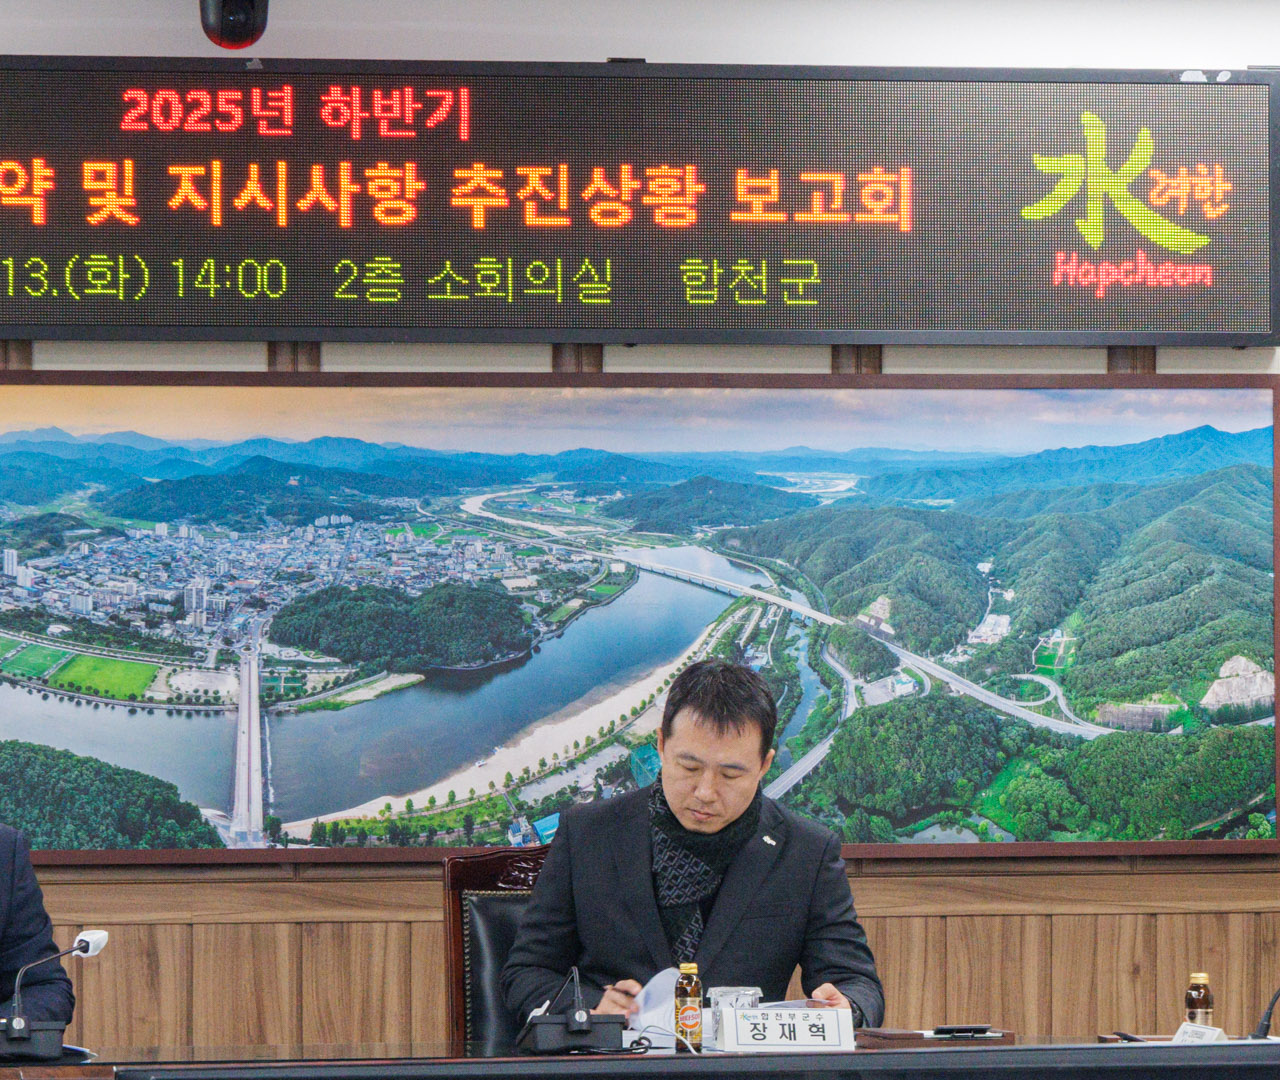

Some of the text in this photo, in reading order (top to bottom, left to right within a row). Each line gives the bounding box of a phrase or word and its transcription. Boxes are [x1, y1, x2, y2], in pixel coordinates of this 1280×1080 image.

[120, 86, 472, 142] 2025년 하반기
[80, 158, 141, 226] 및
[167, 159, 427, 230] 지시사항
[450, 162, 707, 231] 추진상황
[729, 166, 913, 233] 보고회
[170, 258, 286, 298] 14:00
[334, 257, 404, 302] 2층
[426, 258, 613, 304] 소회의실
[680, 259, 822, 305] 합천군
[1053, 249, 1213, 298] Hapcheon
[749, 1022, 826, 1042] 장재혁
